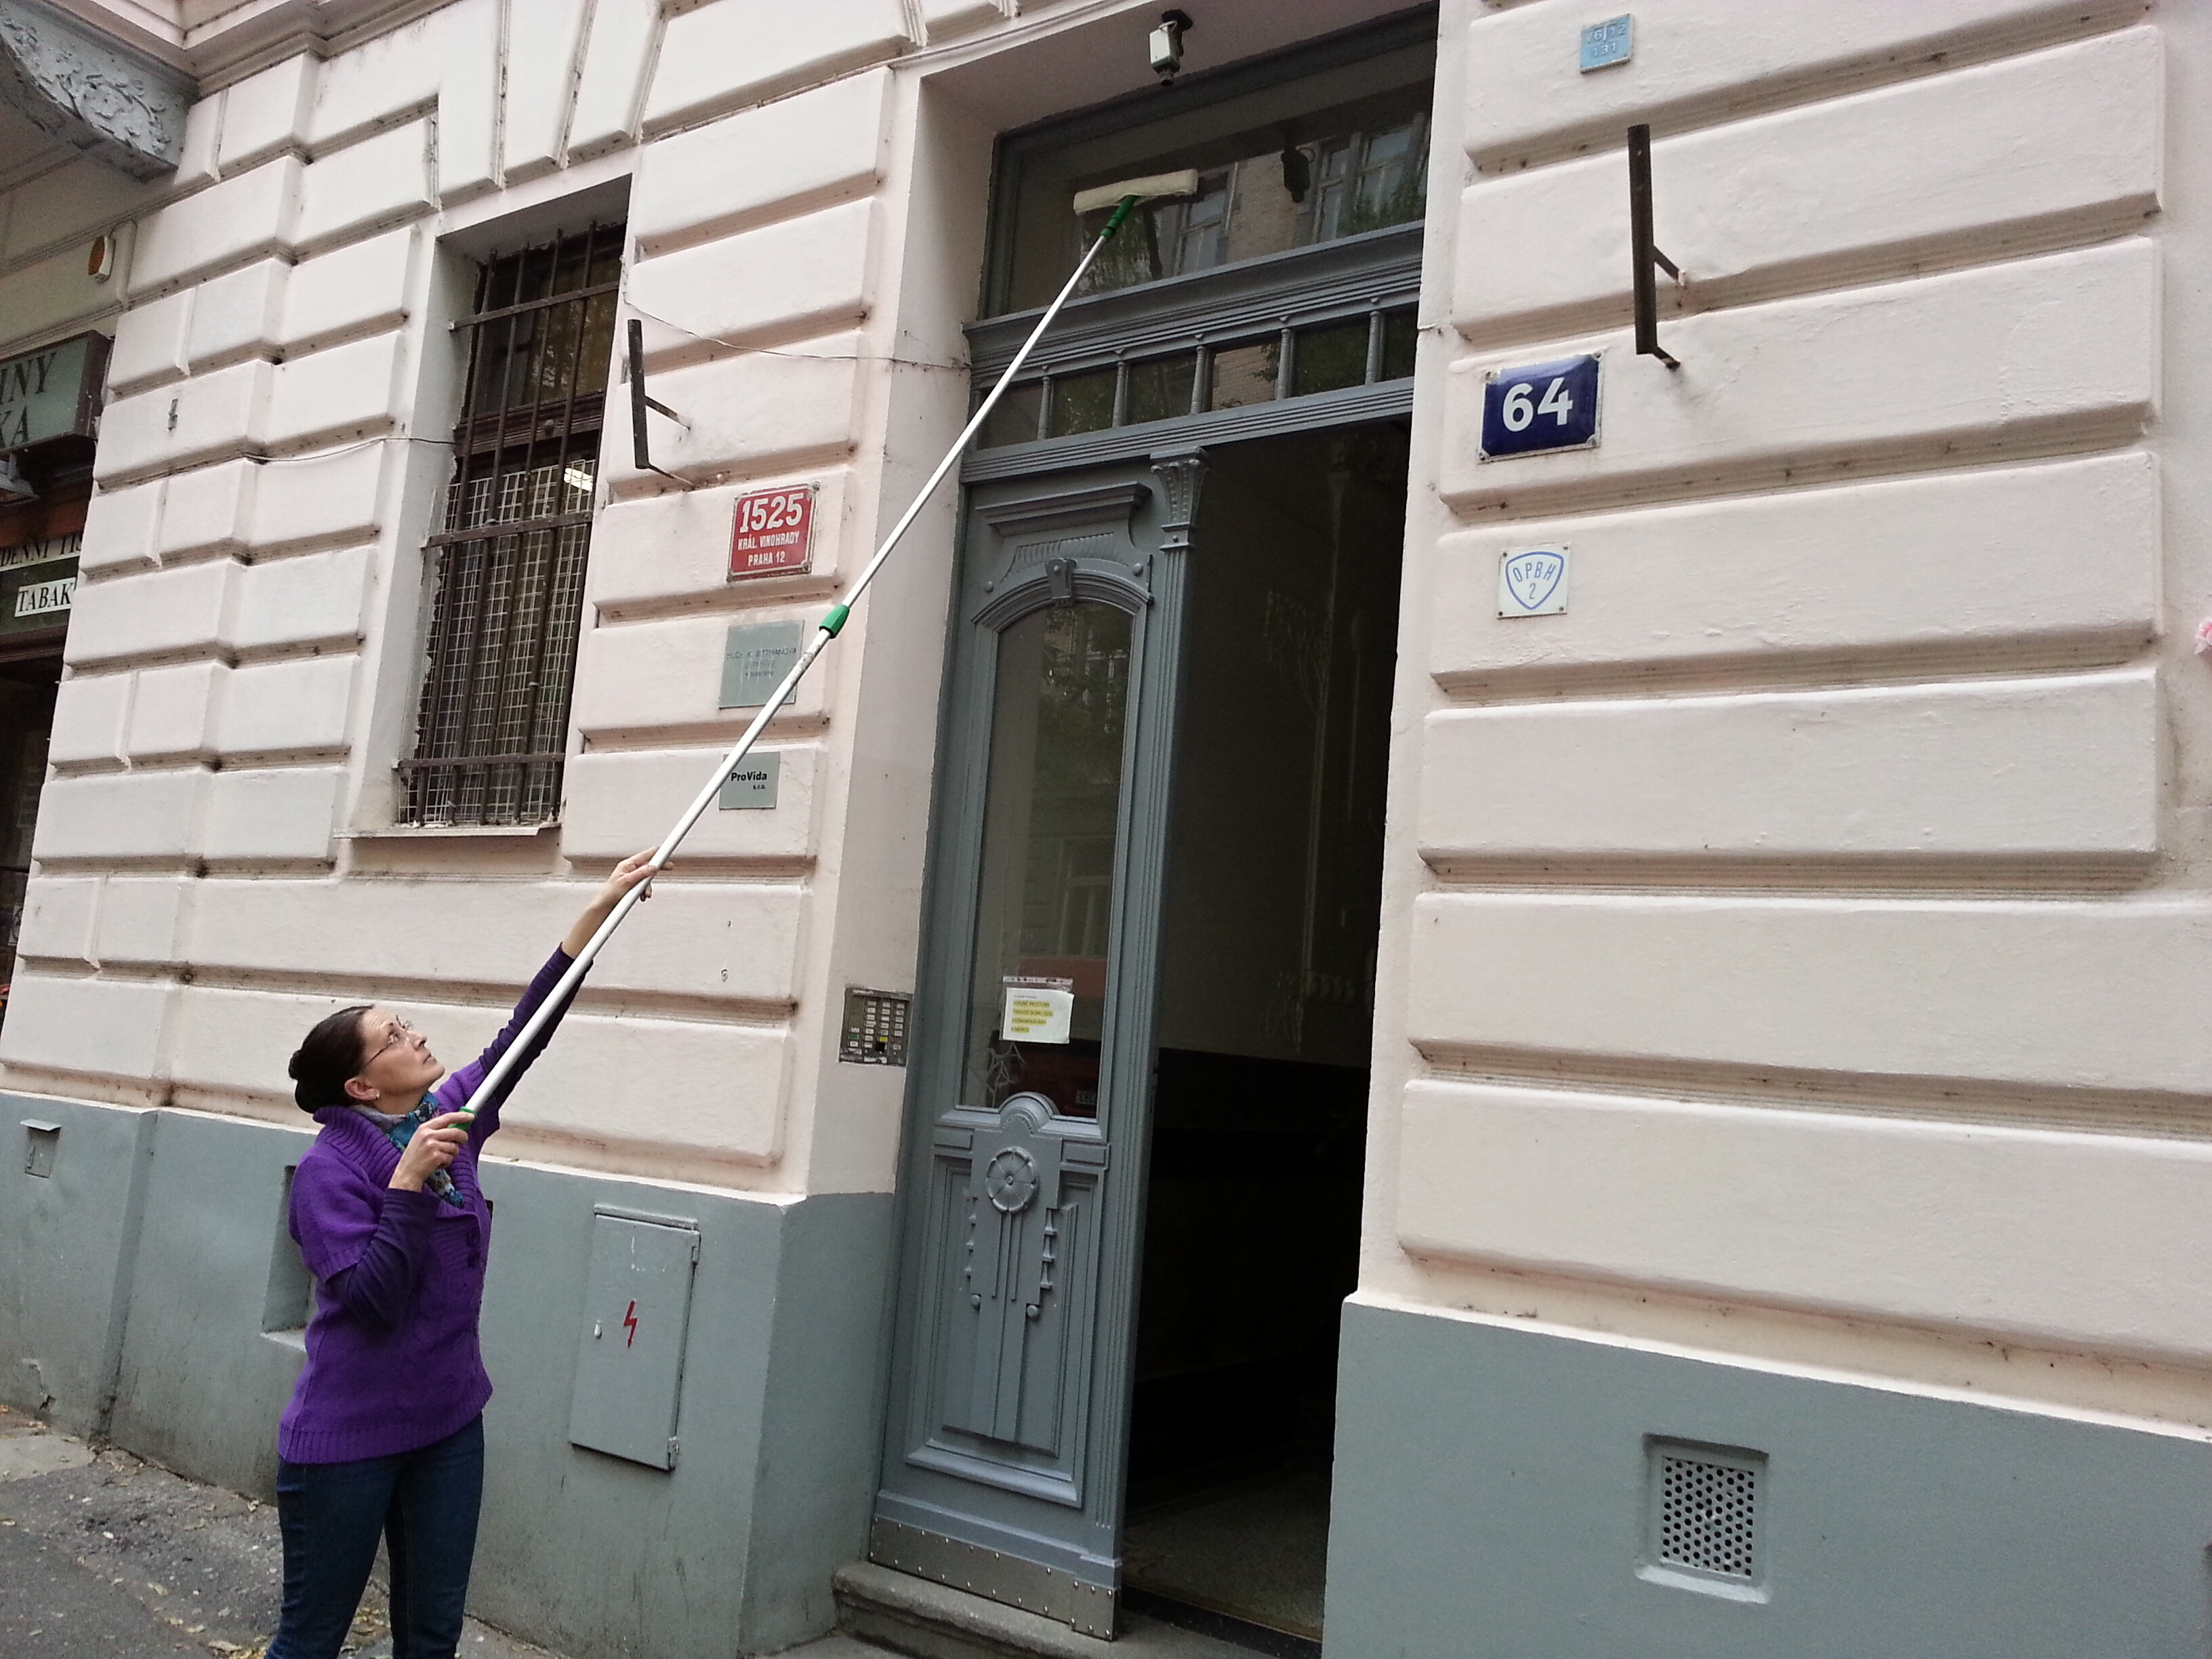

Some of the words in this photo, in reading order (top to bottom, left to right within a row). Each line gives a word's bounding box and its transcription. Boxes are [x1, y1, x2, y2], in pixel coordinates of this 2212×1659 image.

[1502, 377, 1574, 432] 64
[739, 492, 804, 533] 1525
[760, 531, 800, 548] VINOHRADY
[747, 552, 773, 567] PRAHA
[776, 550, 785, 563] 12
[1513, 561, 1557, 583] OPBH
[18, 583, 74, 612] TABAK
[1529, 583, 1536, 600] 2
[731, 771, 767, 781] ProVida
